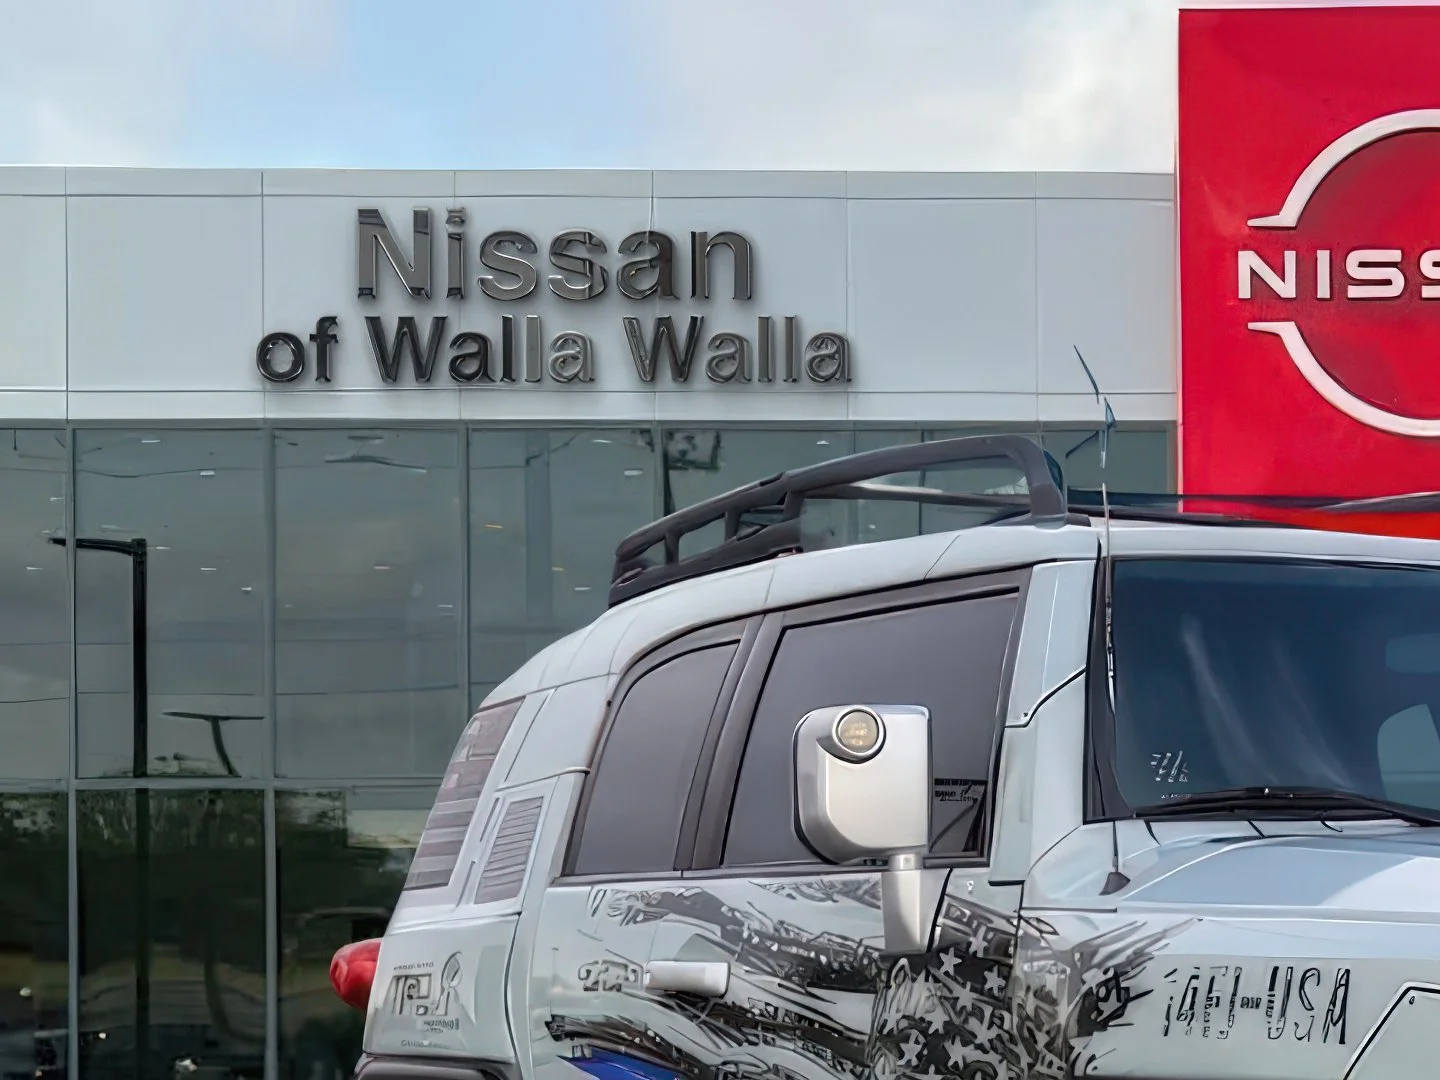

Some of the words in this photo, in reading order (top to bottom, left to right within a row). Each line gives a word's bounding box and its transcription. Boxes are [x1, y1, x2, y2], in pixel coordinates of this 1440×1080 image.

[355, 206, 755, 300] Nissan
[255, 314, 339, 383] of
[363, 314, 596, 383] Walla
[621, 314, 853, 383] Walla
